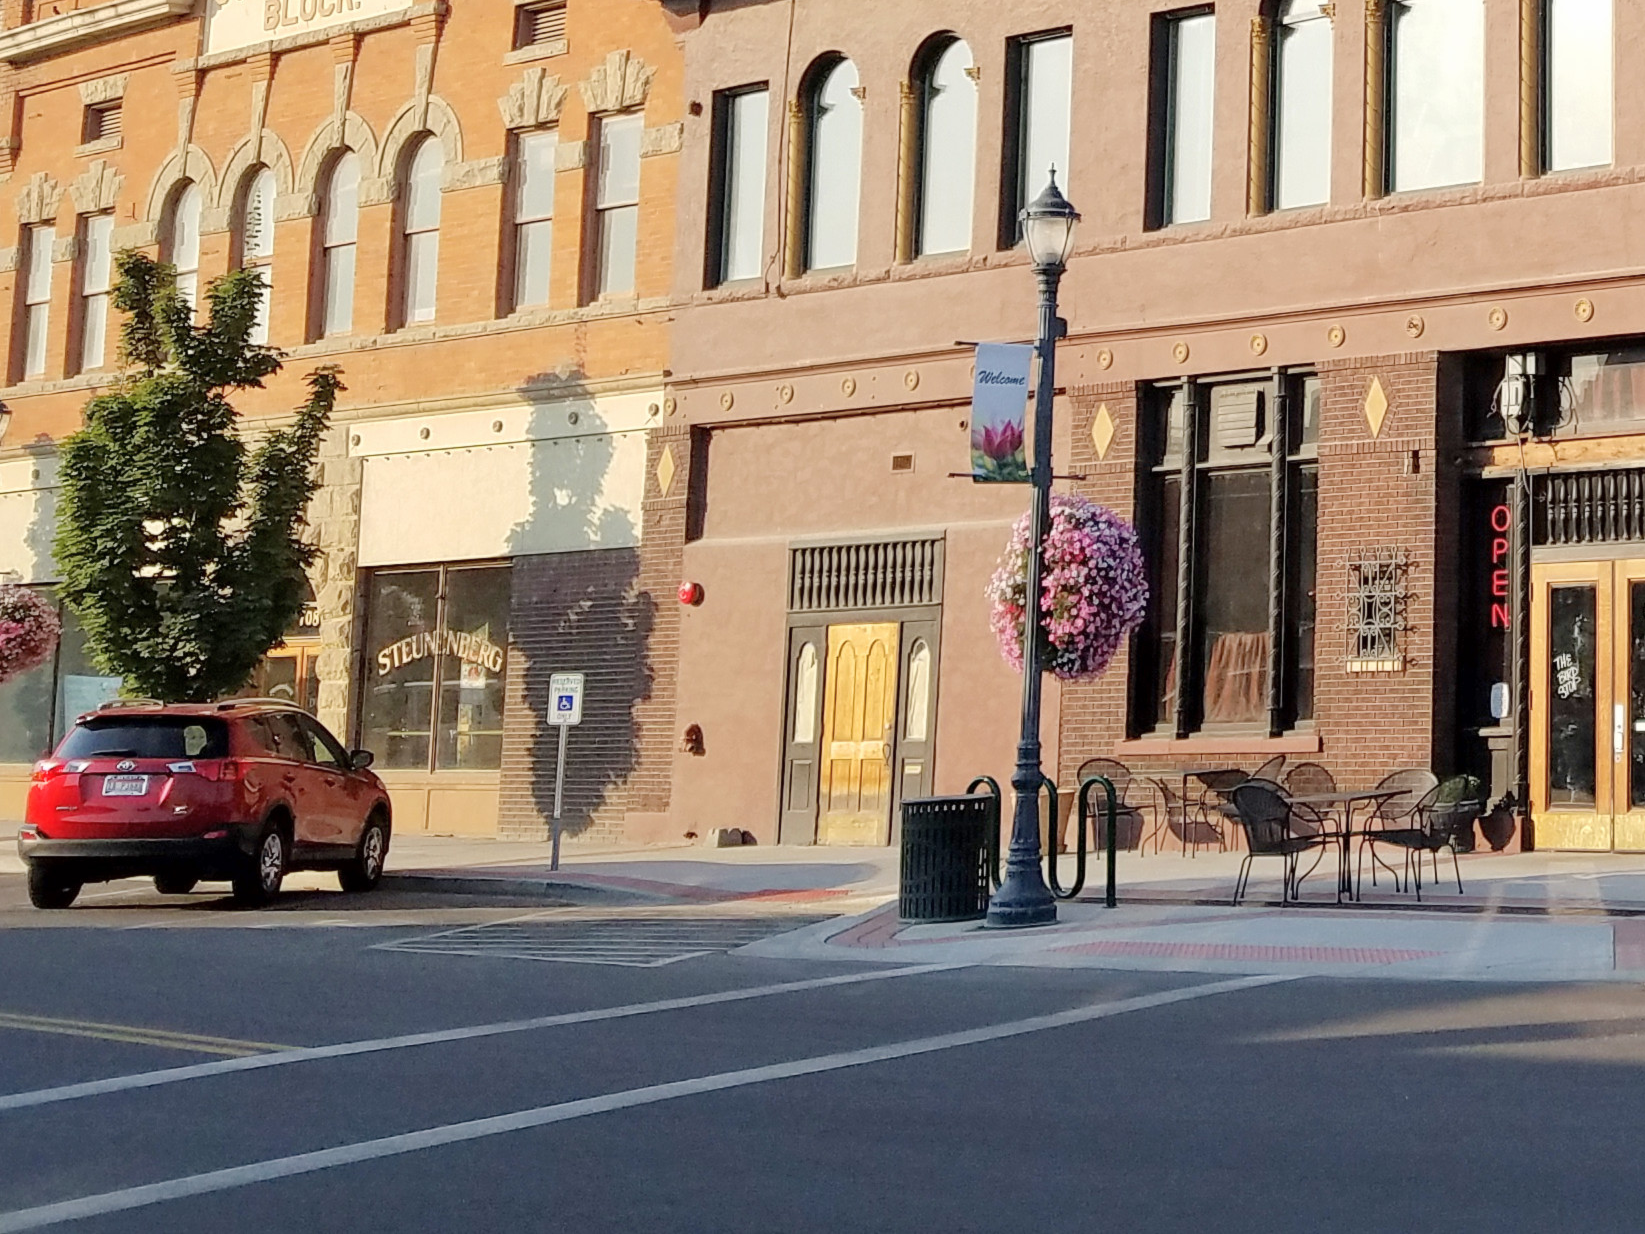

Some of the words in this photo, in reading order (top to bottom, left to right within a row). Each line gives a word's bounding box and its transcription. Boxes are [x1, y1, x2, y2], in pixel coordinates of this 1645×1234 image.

[978, 370, 1025, 385] Welcome
[1491, 505, 1512, 629] OPEN
[1553, 652, 1573, 671] THE
[1556, 666, 1579, 685] BIRD
[1558, 676, 1582, 699] STOP
